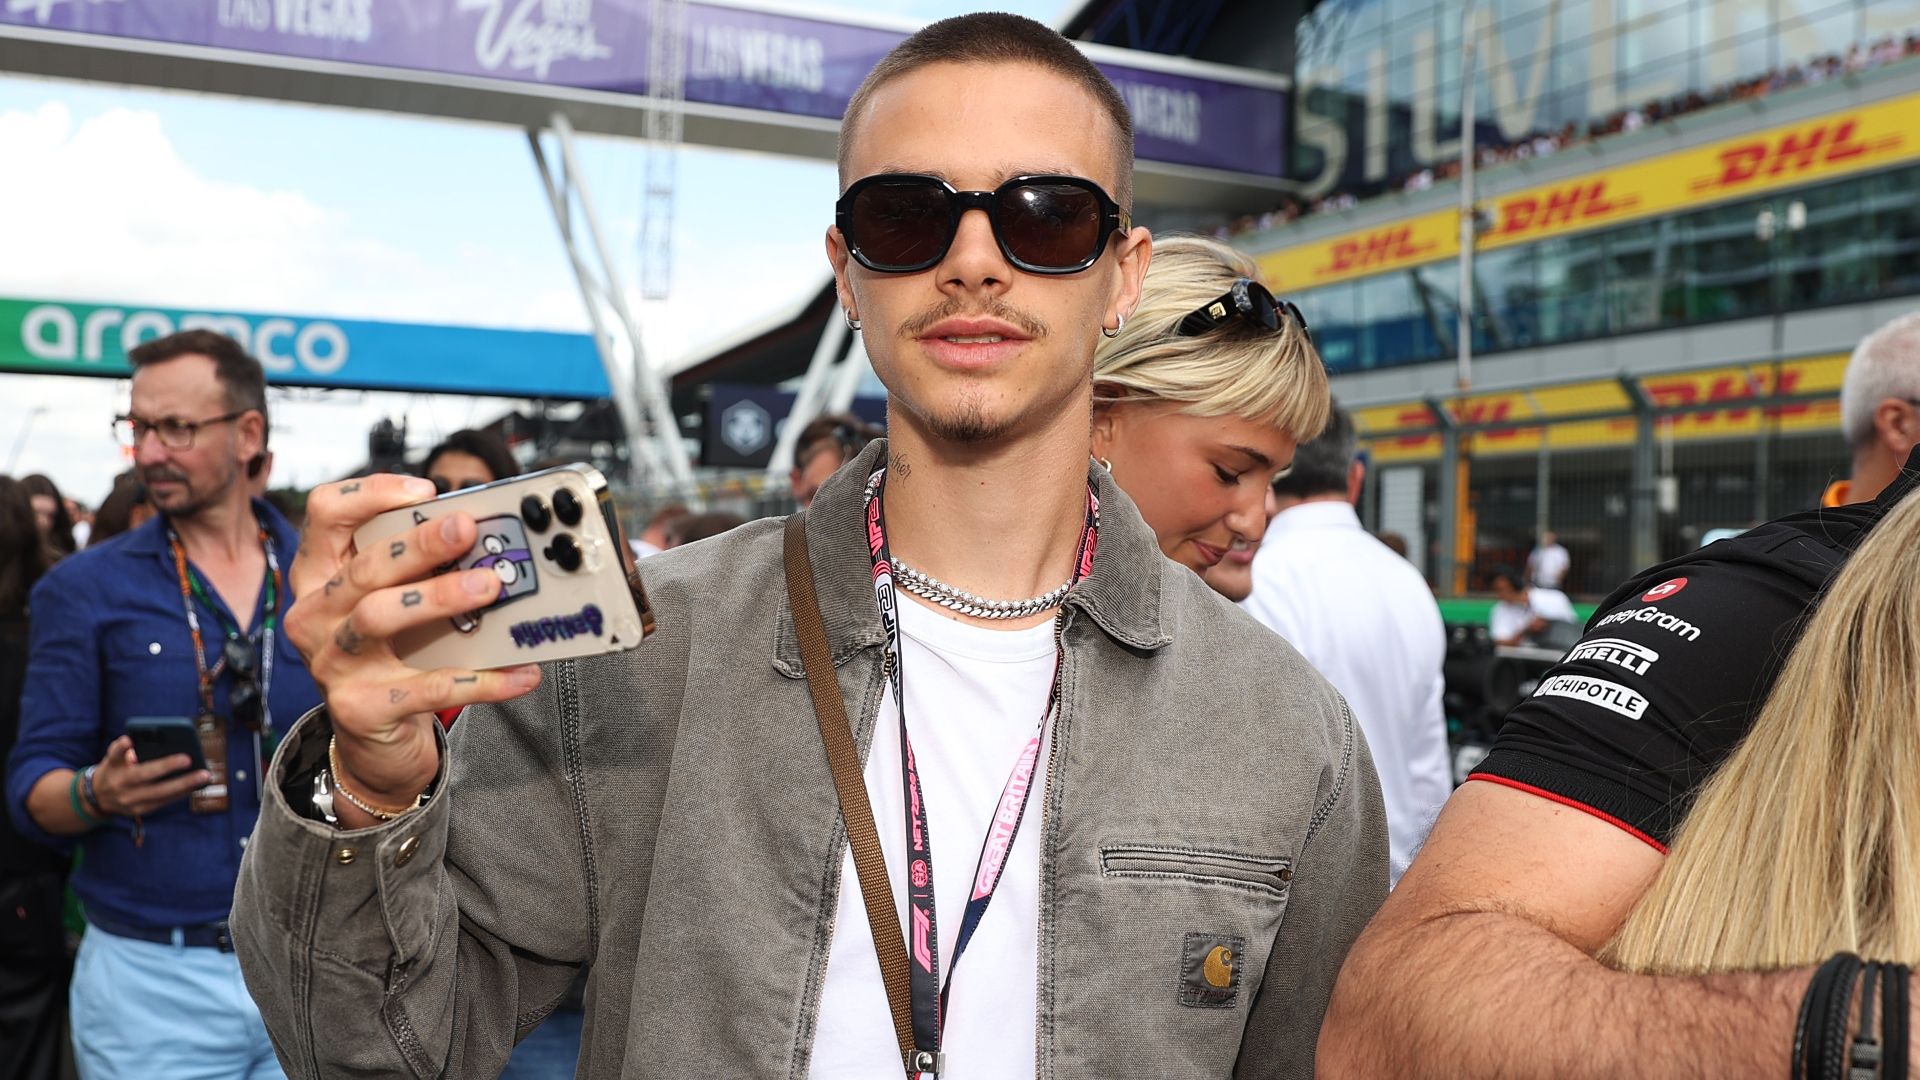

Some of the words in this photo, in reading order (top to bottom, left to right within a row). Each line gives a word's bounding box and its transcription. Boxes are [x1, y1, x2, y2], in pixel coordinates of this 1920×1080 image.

[1720, 117, 1867, 187] DHL
[1502, 179, 1613, 234] DHL
[1330, 216, 1417, 271] DHL
[1078, 526, 1097, 582] IP23
[1552, 679, 1642, 712] CHIPOTLE
[912, 819, 923, 851] NET
[978, 825, 1012, 894] GREAT
[998, 743, 1038, 825] BRITAIN
